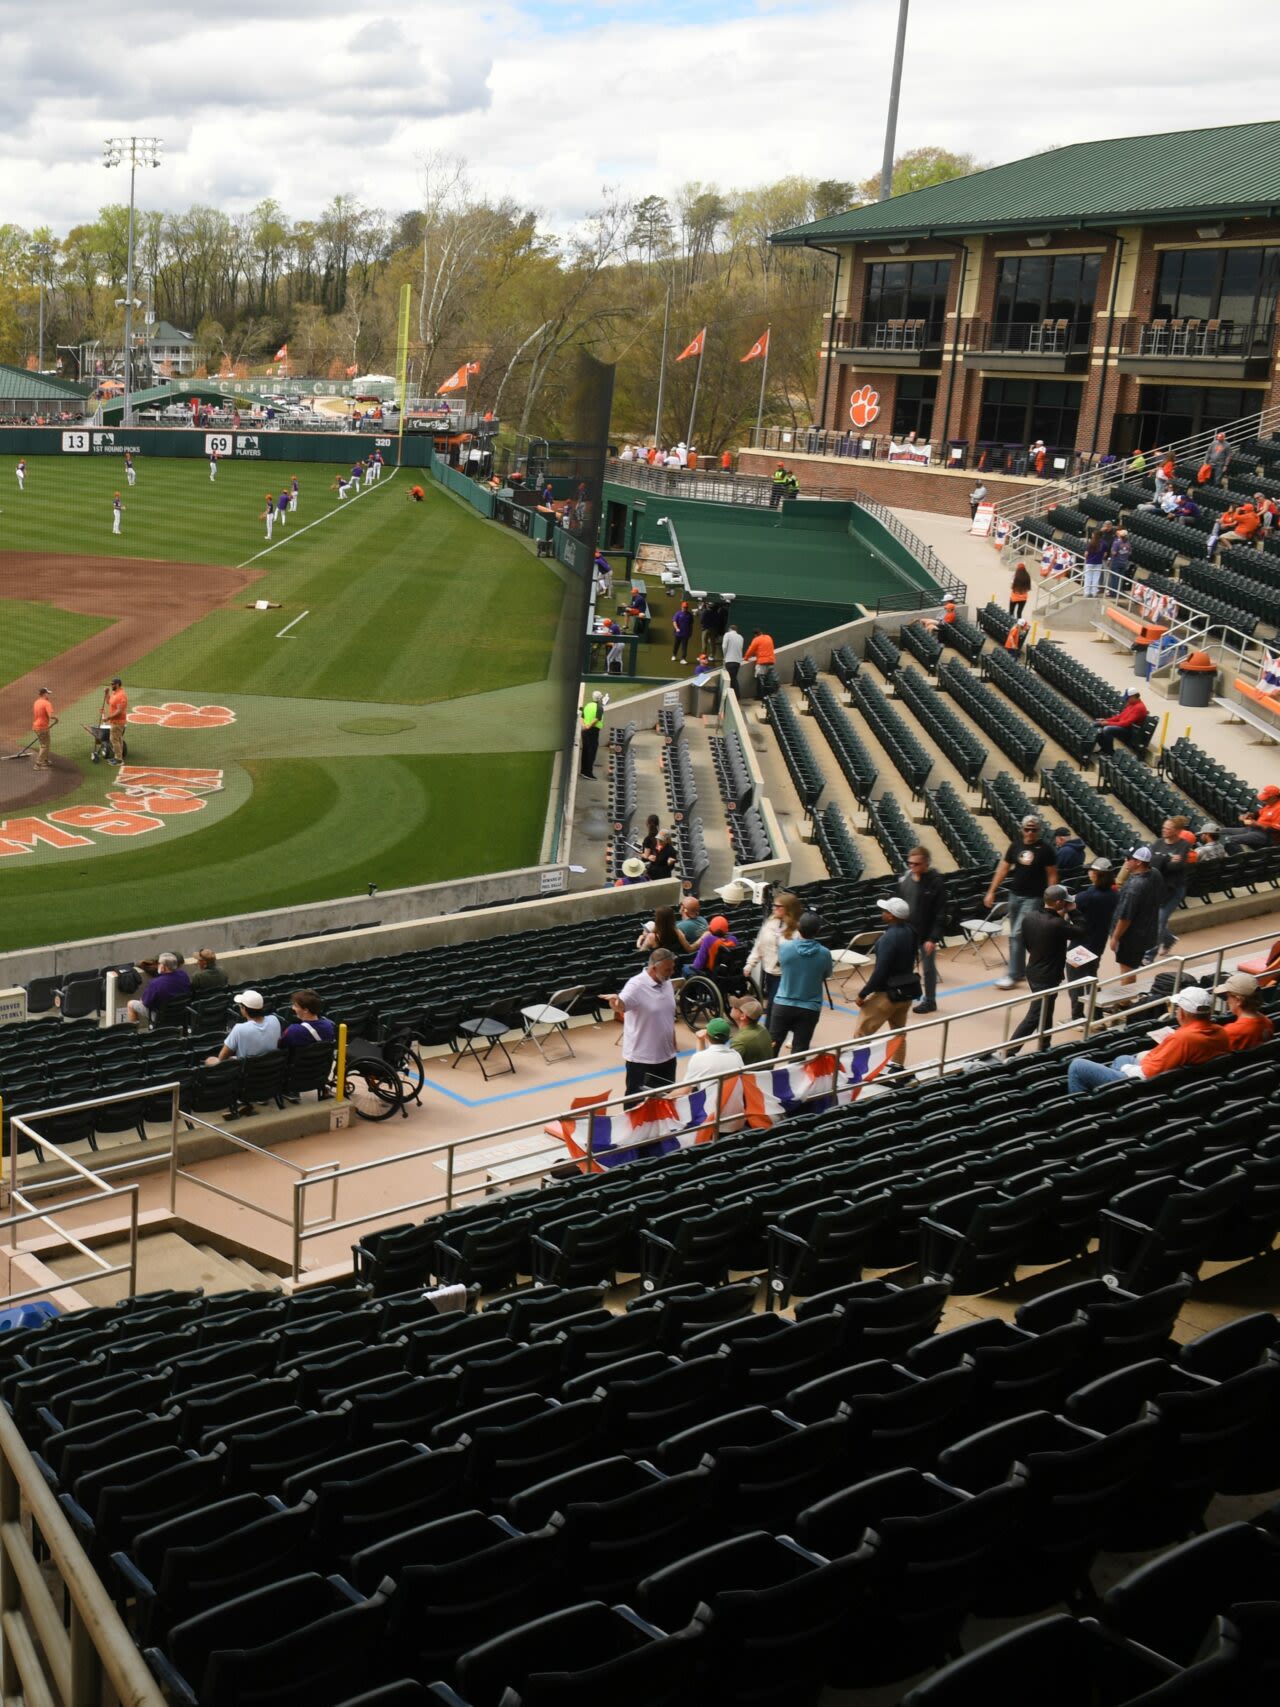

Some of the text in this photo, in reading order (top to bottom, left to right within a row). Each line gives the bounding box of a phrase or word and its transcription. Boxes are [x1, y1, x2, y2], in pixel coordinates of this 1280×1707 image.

[68, 436, 84, 449] 13
[210, 437, 228, 451] 69
[375, 438, 391, 447] 320
[236, 449, 262, 457] PLAYERS
[9, 1011, 23, 1019] ONLY
